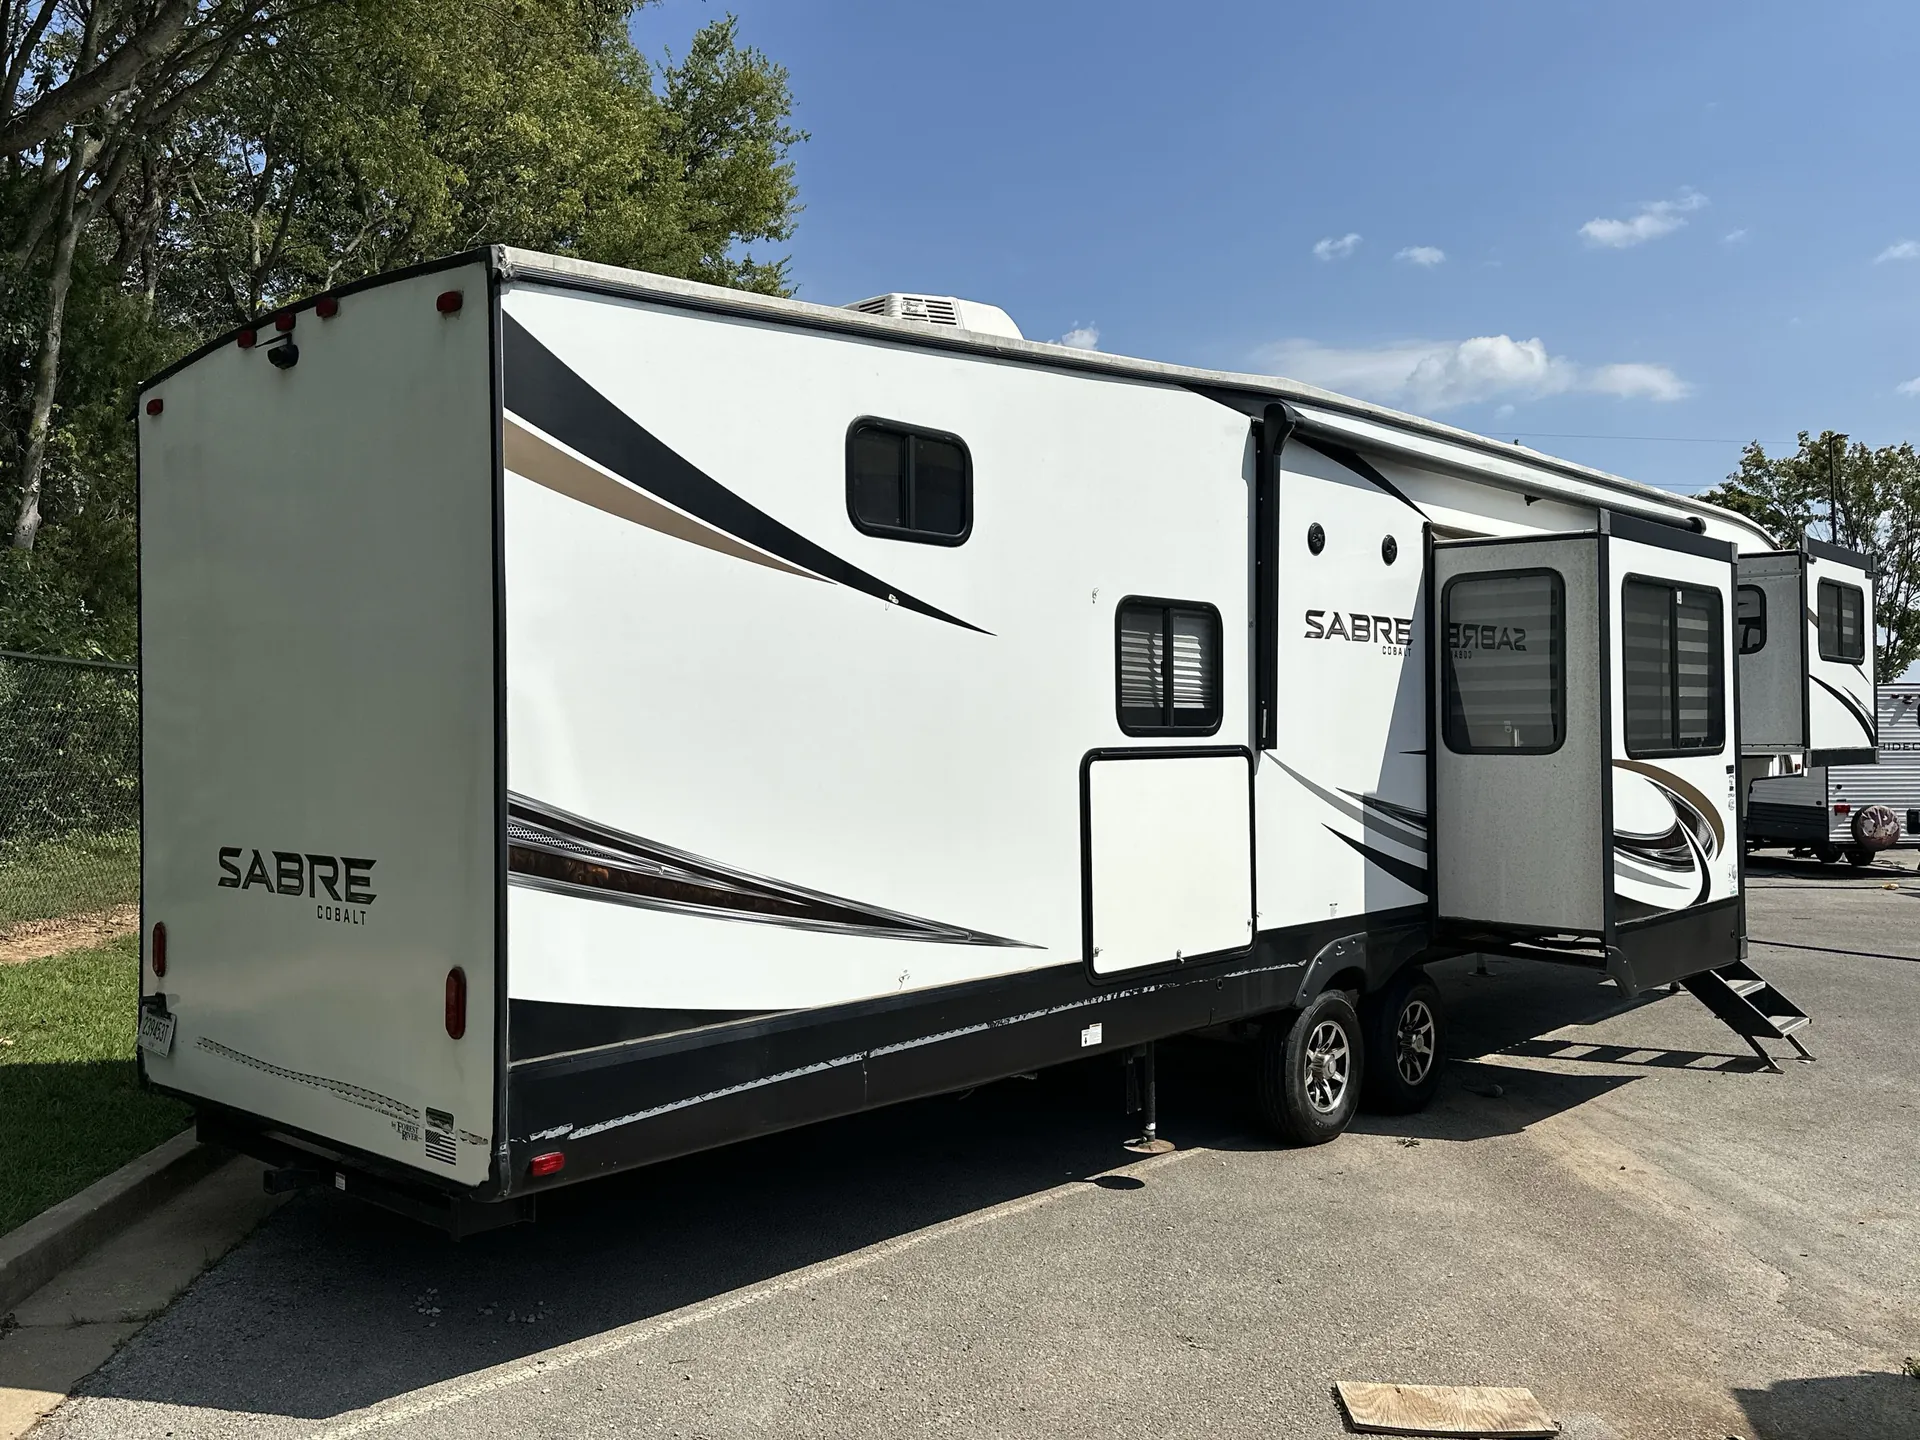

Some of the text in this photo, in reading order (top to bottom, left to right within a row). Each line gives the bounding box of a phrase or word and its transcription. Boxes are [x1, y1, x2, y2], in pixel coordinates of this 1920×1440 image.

[1304, 609, 1413, 645] SABRE
[1382, 646, 1412, 657] COBALT
[218, 846, 377, 905] SABRE
[317, 905, 367, 926] COBALT
